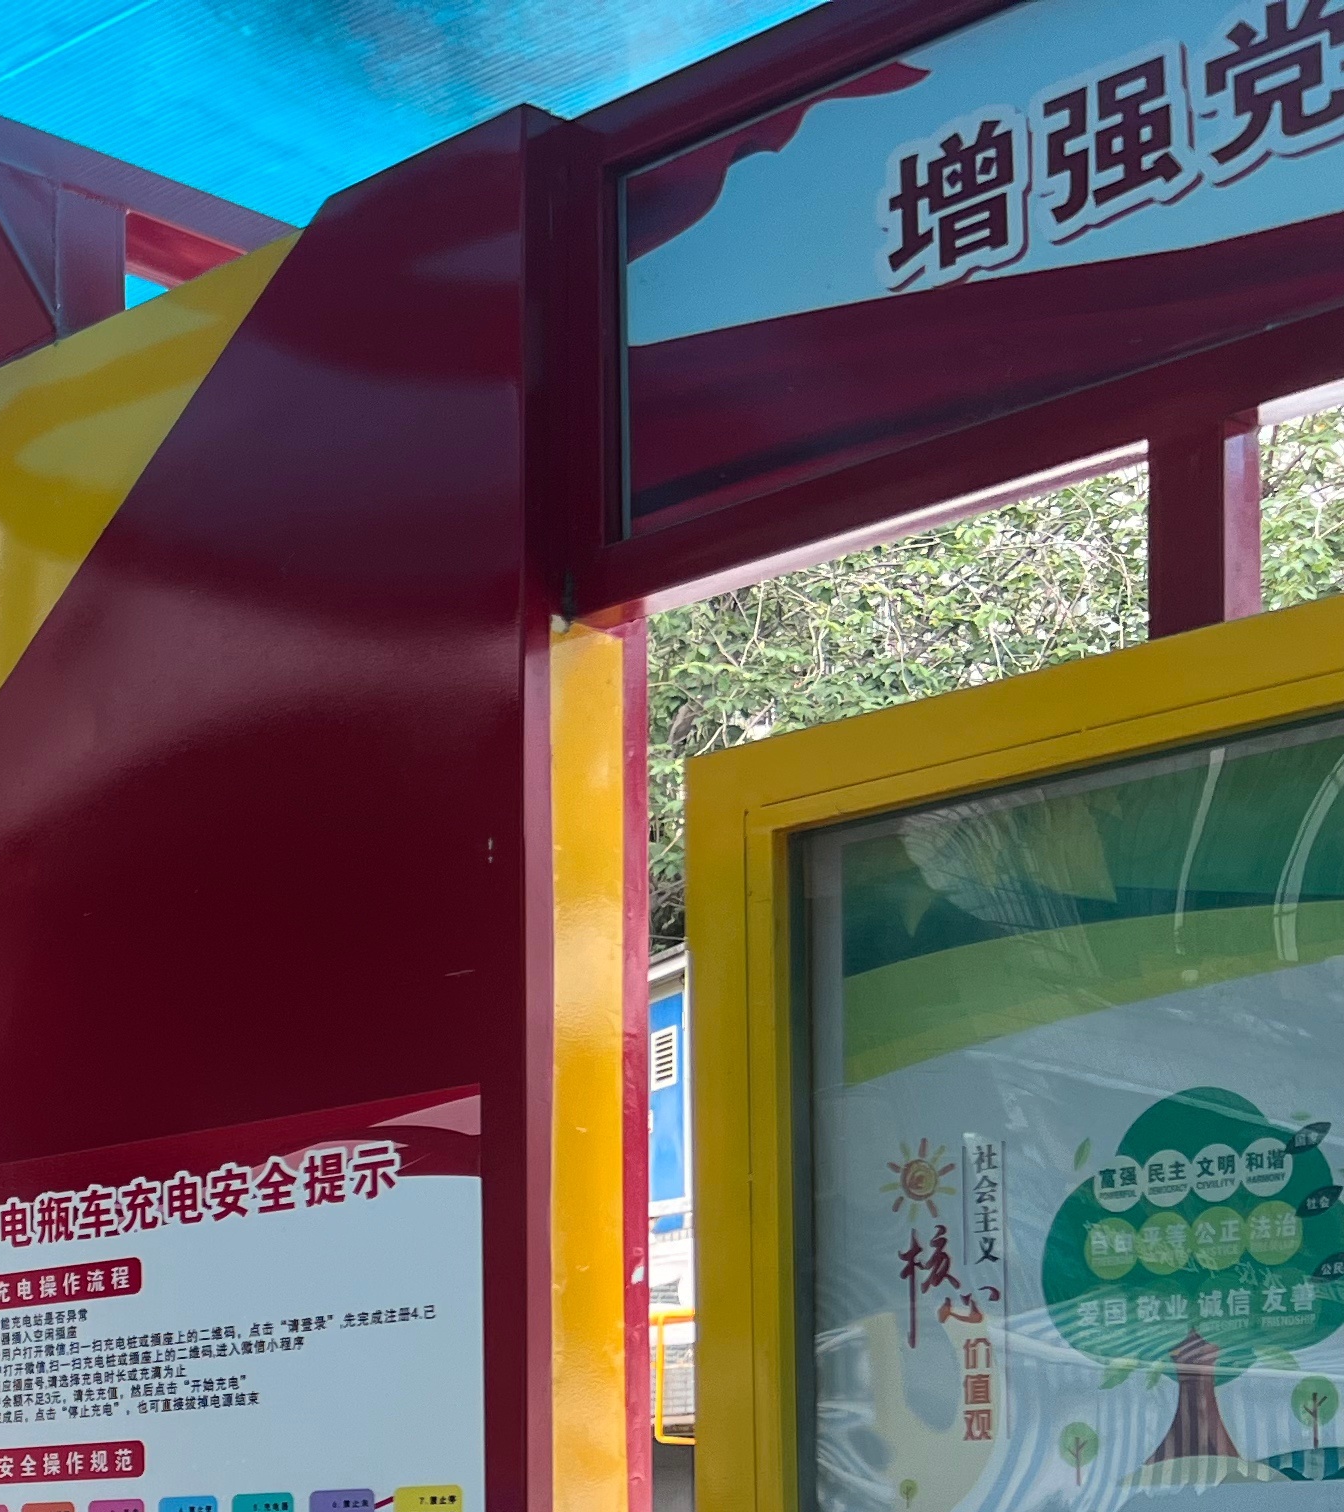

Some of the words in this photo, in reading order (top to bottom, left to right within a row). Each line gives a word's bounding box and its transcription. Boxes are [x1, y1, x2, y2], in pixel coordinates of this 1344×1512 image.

[888, 0, 1344, 273] 增强党
[1099, 1166, 1137, 1189] 富强
[1148, 1161, 1186, 1183] 民主
[1196, 1154, 1235, 1178] 文明
[1246, 1149, 1285, 1172] 和谐
[972, 1143, 1000, 1264] 社会主义
[1306, 1196, 1330, 1210] 社会
[1090, 1230, 1134, 1255] 自由
[1143, 1224, 1187, 1247] 平等
[1195, 1219, 1241, 1243] 公正
[1250, 1213, 1297, 1240] 法治
[898, 1225, 1000, 1349] 核心
[1321, 1261, 1344, 1276] 公民
[1077, 1299, 1127, 1326] 爱国
[1136, 1295, 1188, 1322] 敬业
[1198, 1288, 1250, 1317] 诚信
[1262, 1281, 1317, 1313] 友善
[963, 1338, 993, 1442] 价值观
